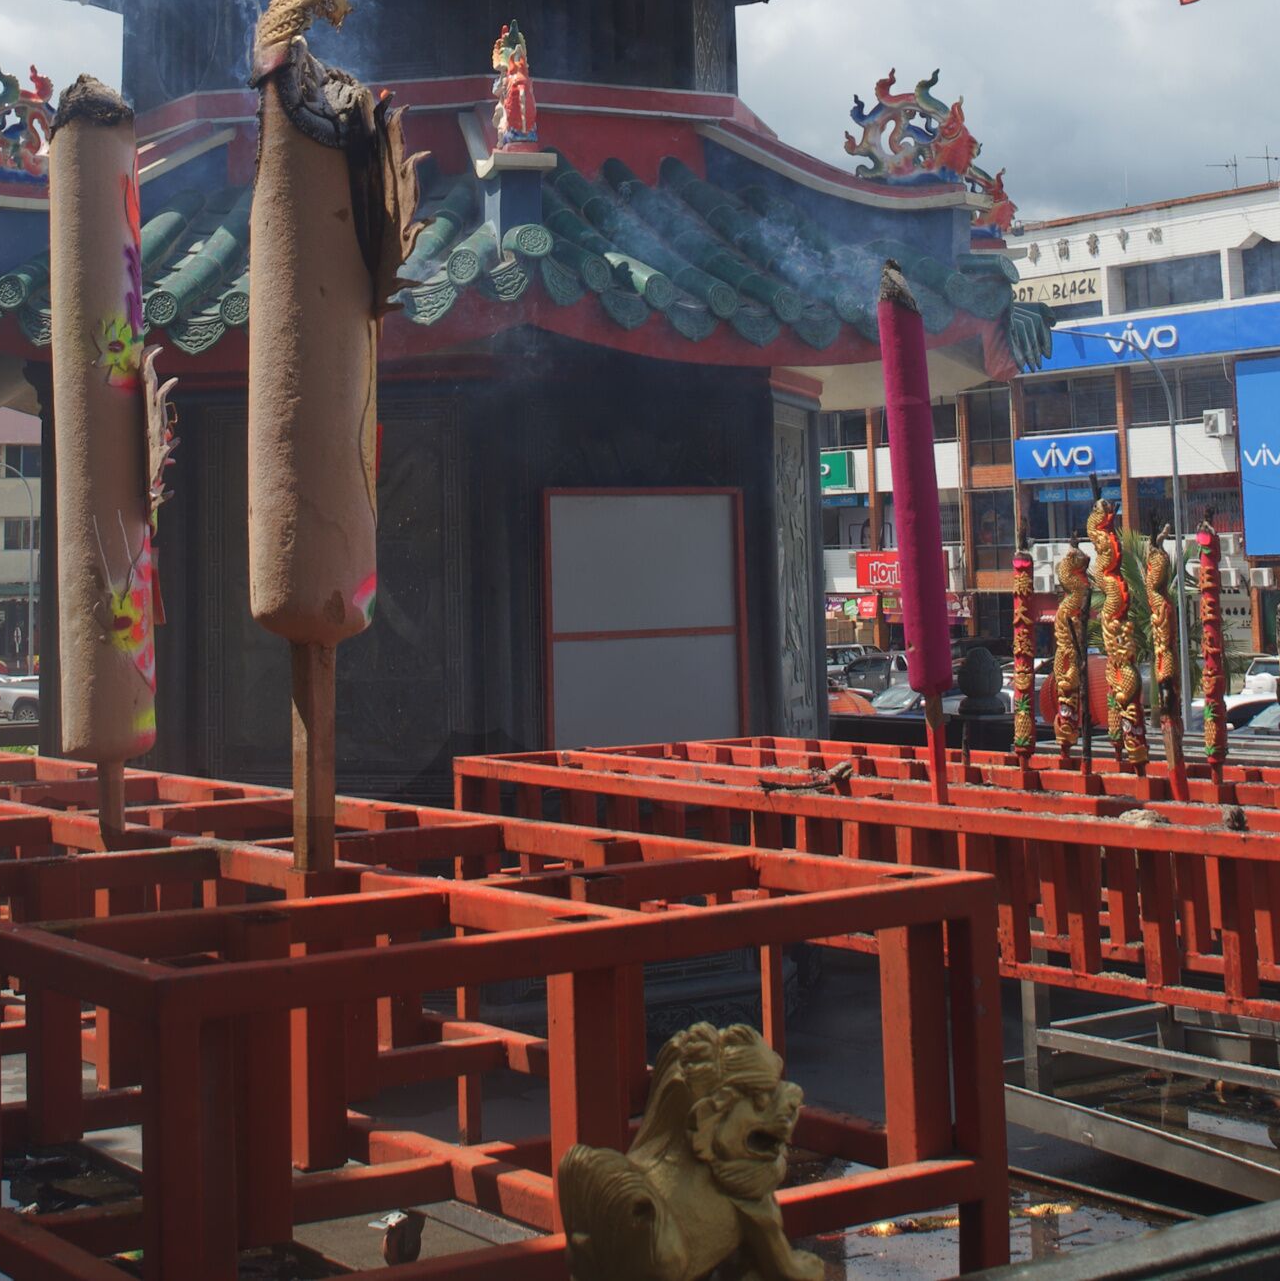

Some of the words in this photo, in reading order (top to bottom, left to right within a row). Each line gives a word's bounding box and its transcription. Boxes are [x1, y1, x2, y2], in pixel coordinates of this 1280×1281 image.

[1052, 278, 1097, 300] BLACK
[1104, 322, 1177, 353] vivo
[1032, 442, 1093, 468] vivo
[869, 561, 902, 585] HOTL
